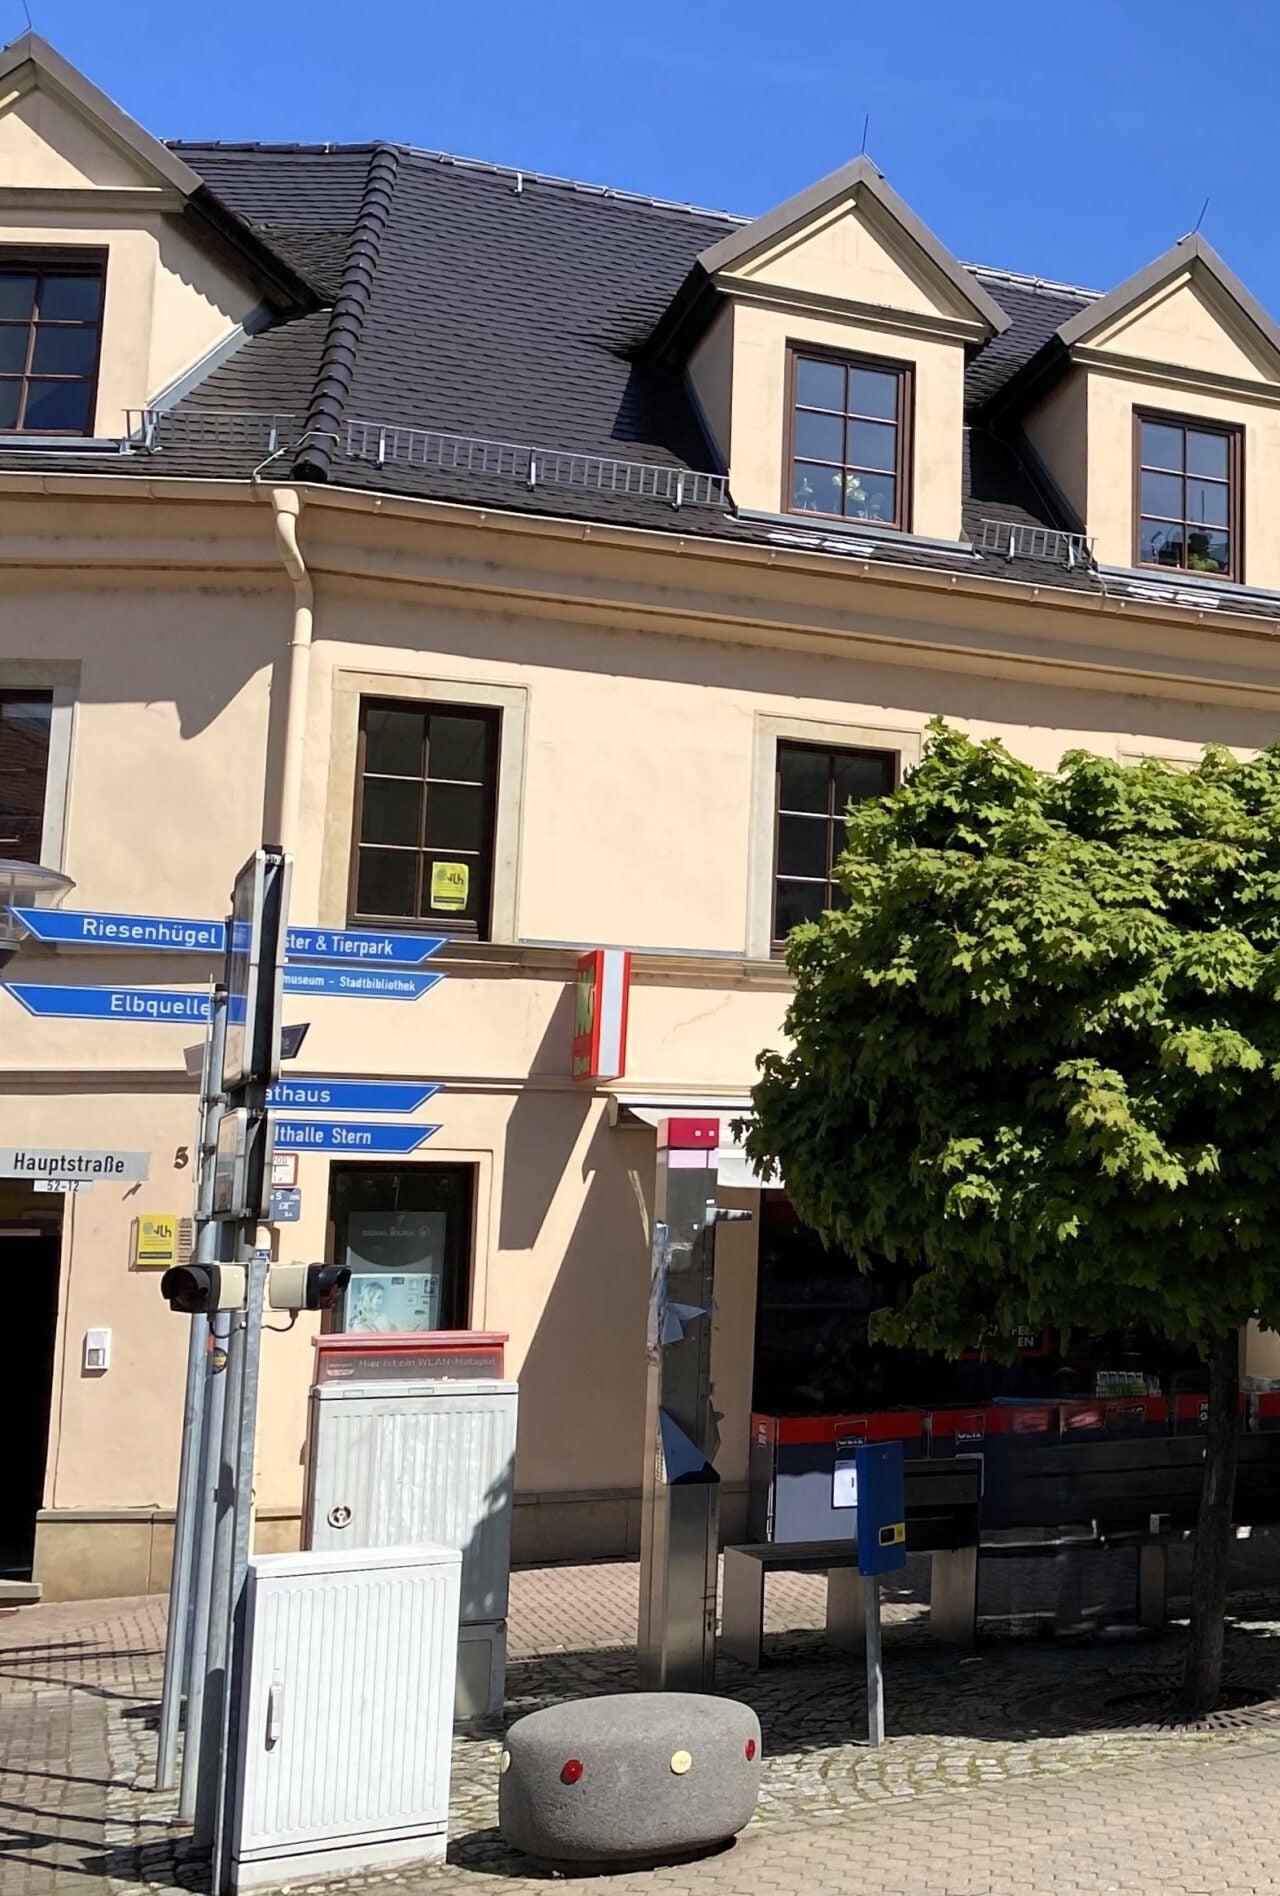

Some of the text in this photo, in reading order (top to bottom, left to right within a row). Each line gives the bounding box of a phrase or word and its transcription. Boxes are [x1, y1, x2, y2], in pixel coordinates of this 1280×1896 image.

[82, 918, 216, 946] Riesenhügel
[285, 934, 393, 957] ster & Tierpark
[283, 975, 325, 986] museum
[339, 976, 415, 991] Stadtbibliothek
[111, 994, 211, 1017] Elbquelle
[265, 1085, 331, 1103] athaus
[275, 1125, 371, 1145] thalle Stern
[14, 1152, 125, 1175] Hauptstraße
[173, 1146, 189, 1170] 5
